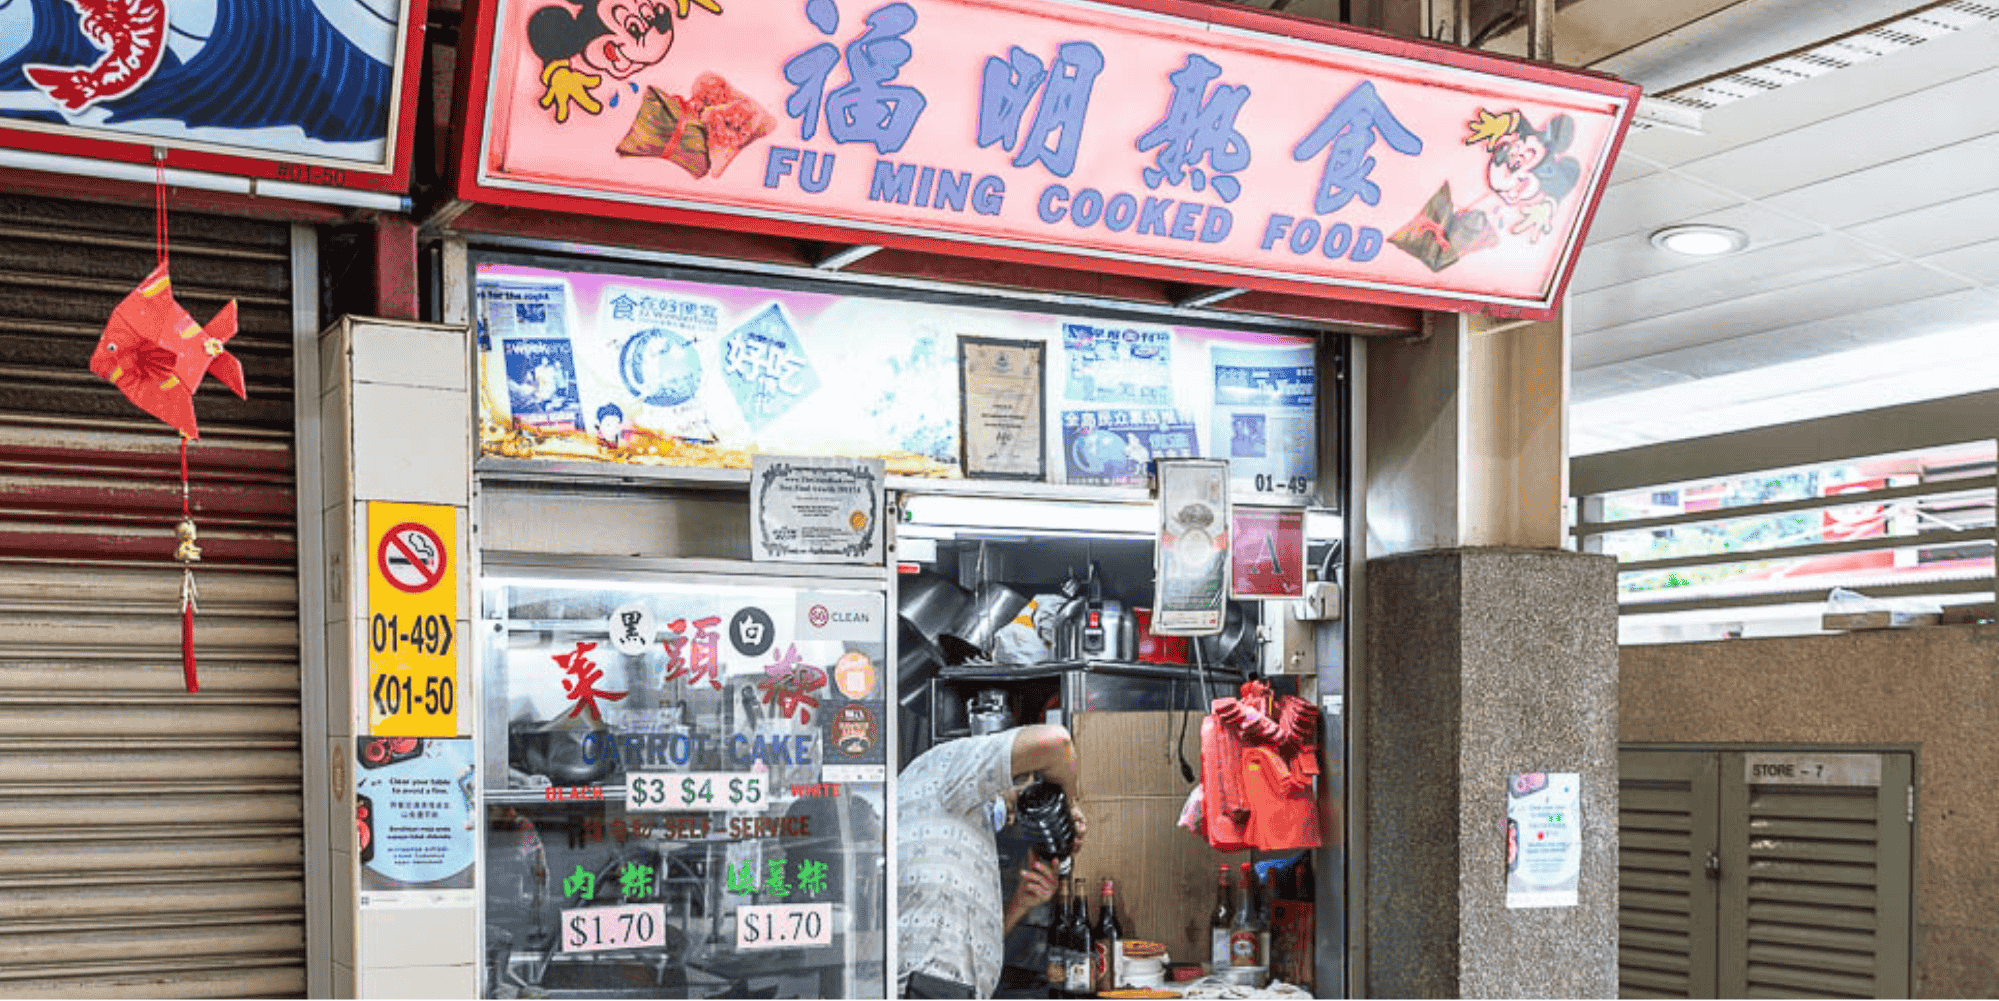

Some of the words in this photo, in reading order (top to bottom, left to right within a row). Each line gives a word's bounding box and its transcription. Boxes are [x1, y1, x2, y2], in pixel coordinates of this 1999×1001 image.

[764, 146, 836, 193] FU
[869, 164, 1006, 216] MING
[1038, 184, 1233, 244] COOKED
[1260, 214, 1383, 263] FOOD
[1255, 474, 1307, 494] 01-49
[1250, 531, 1283, 574] A
[620, 611, 645, 645] 黑
[739, 615, 765, 646] 白
[831, 612, 869, 623] CLEAN
[372, 613, 440, 654] 01-49
[386, 676, 453, 715] 01-50
[583, 733, 710, 765] CARROT
[731, 733, 812, 764] CAKE
[389, 777, 409, 785] Clear
[412, 779, 428, 787] your
[431, 778, 451, 786] table
[1753, 764, 1796, 778] STORE
[1815, 764, 1824, 778] 7
[545, 786, 604, 801] BLACK
[632, 777, 665, 806] $3
[681, 777, 713, 805] $4
[729, 777, 761, 804] $5
[790, 783, 841, 798] WHITE
[663, 816, 811, 839] SELF-SERVICE
[569, 911, 654, 947] $1.70
[743, 910, 822, 944] $1.70
